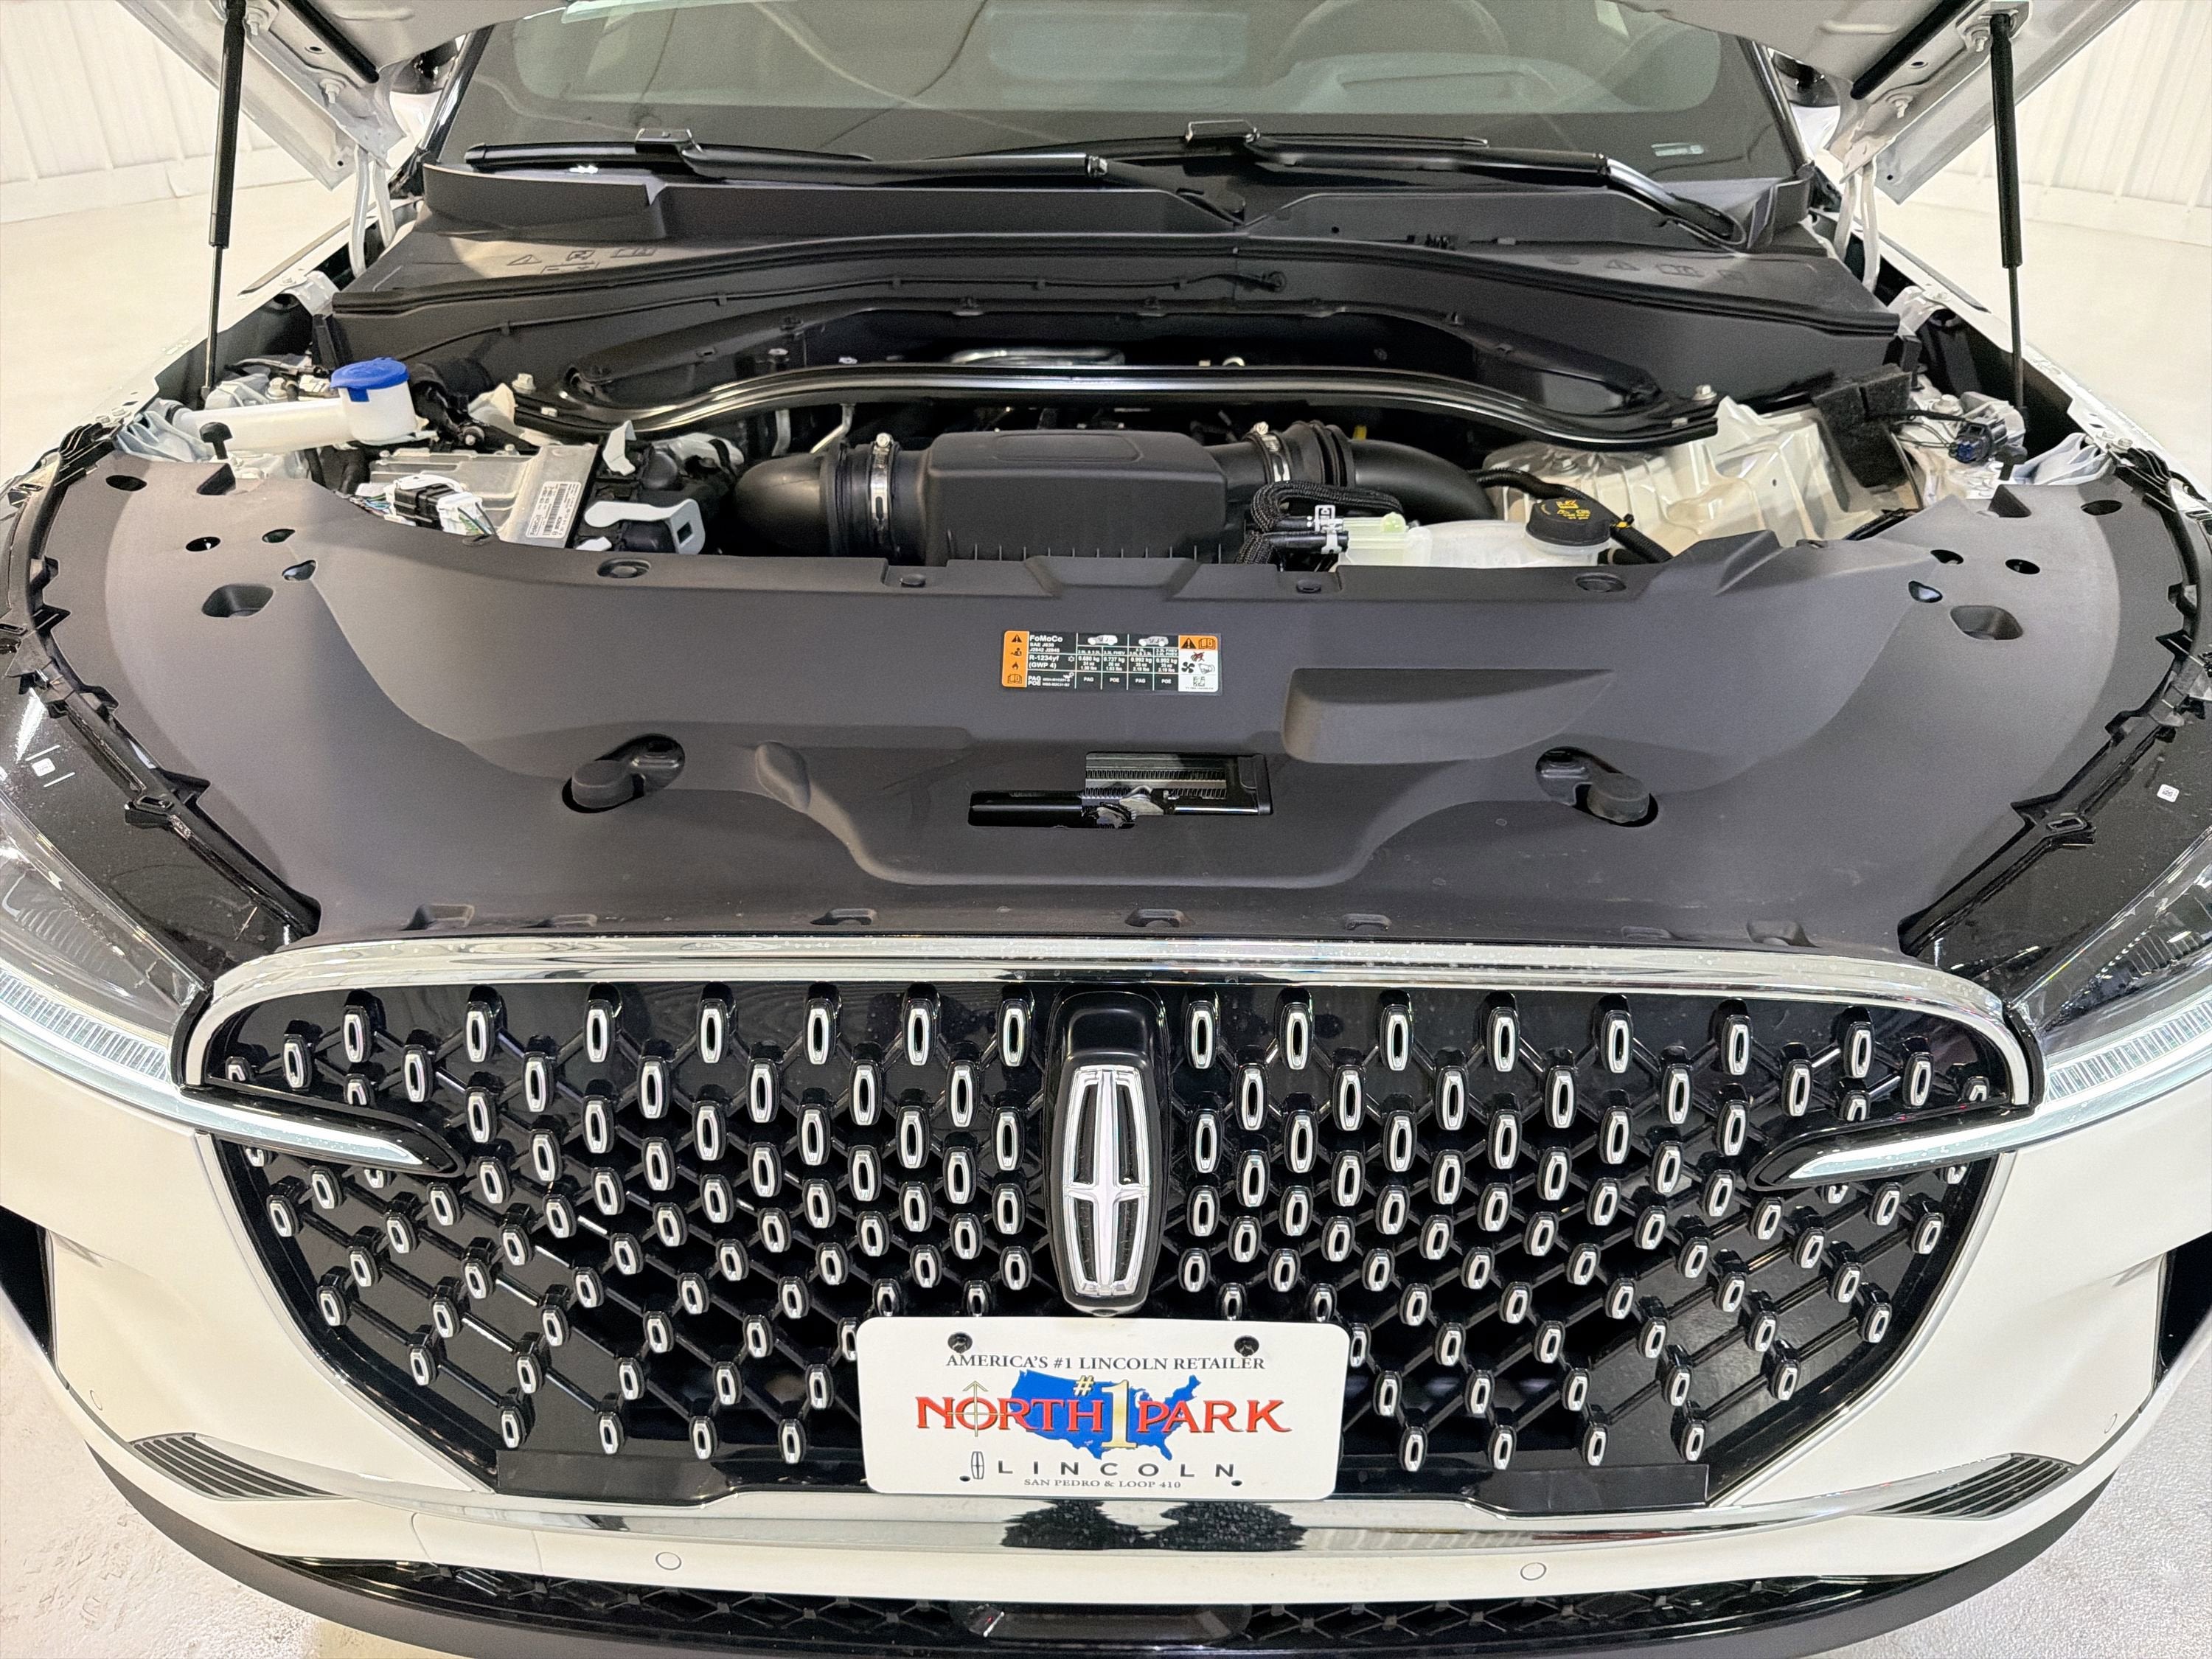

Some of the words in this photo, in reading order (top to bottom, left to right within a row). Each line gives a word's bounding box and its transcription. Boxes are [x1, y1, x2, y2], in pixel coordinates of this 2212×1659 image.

[946, 1354, 1048, 1368] AMERICA'S
[1054, 1357, 1072, 1369] #1
[1079, 1357, 1168, 1370] LINCOLN
[1173, 1357, 1265, 1370] RETAILER
[915, 1396, 1105, 1433] NORTH
[1138, 1399, 1292, 1433] PARK
[998, 1460, 1234, 1478] LINCOLN
[1024, 1478, 1050, 1486] SAN
[1055, 1479, 1100, 1487] PEDRO
